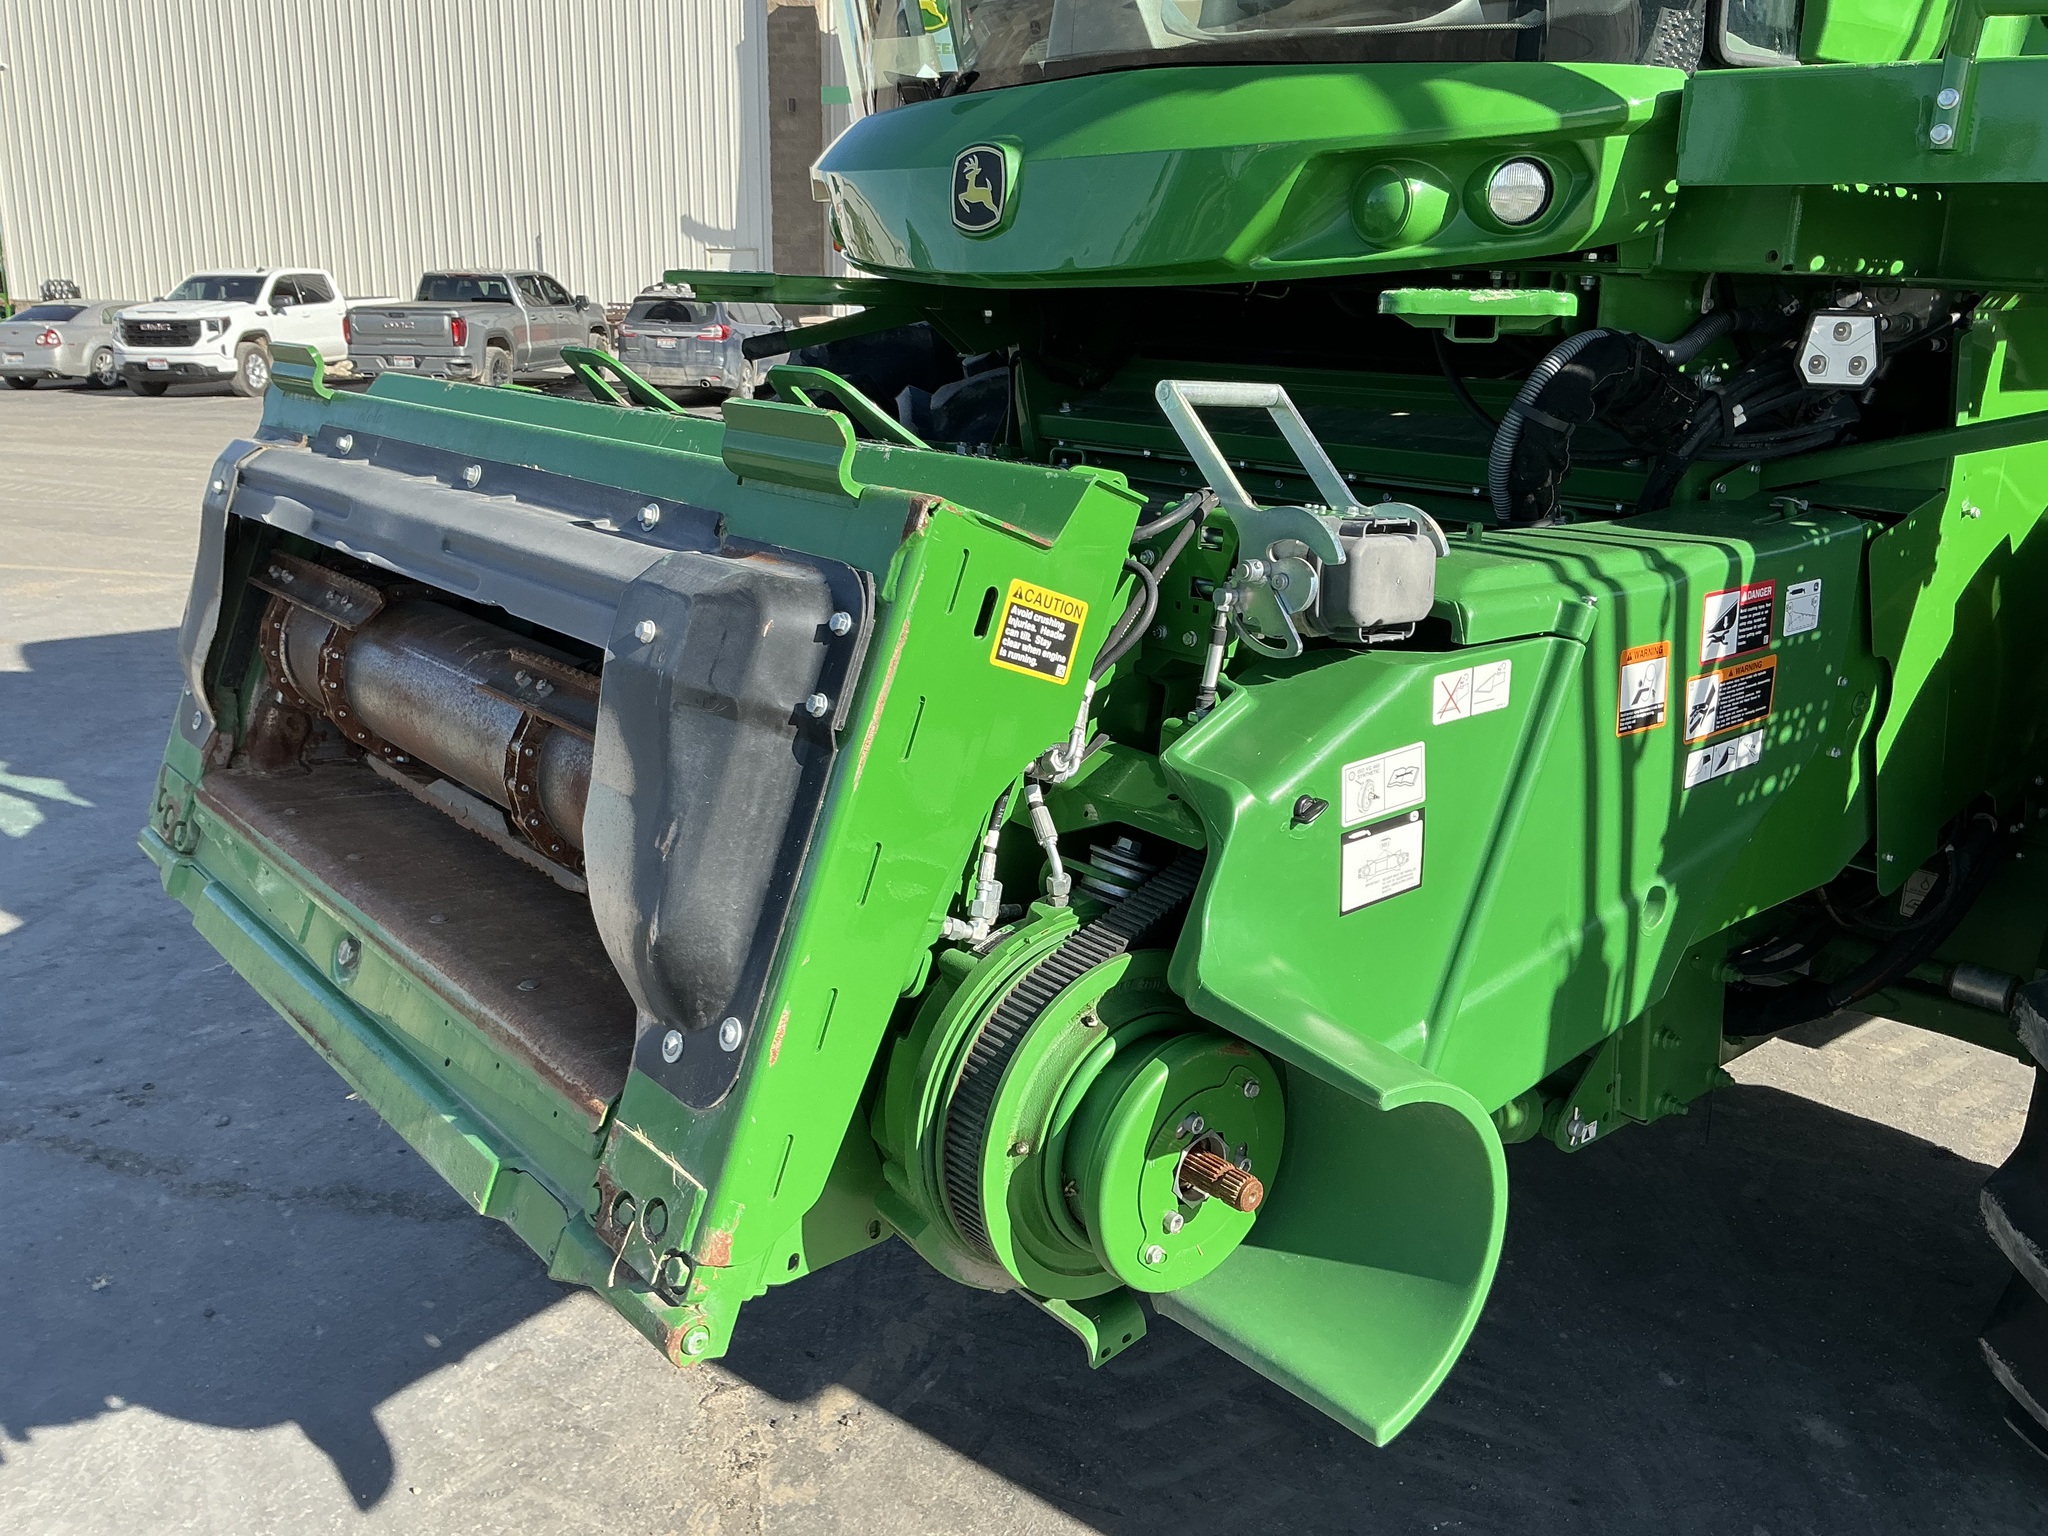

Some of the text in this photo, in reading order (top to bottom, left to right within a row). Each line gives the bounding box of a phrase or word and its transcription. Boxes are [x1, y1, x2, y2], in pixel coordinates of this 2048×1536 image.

[1747, 585, 1773, 600] DANGER
[1024, 588, 1084, 620] CAUTION
[1010, 605, 1066, 631] Avoid crushing
[1004, 628, 1019, 639] can
[1034, 635, 1053, 649] Stay
[1040, 625, 1067, 642] Header
[1001, 637, 1067, 663] clear when engine
[1633, 645, 1664, 660] WARNING
[1007, 651, 1038, 668] running.
[1735, 660, 1763, 675] WARNING
